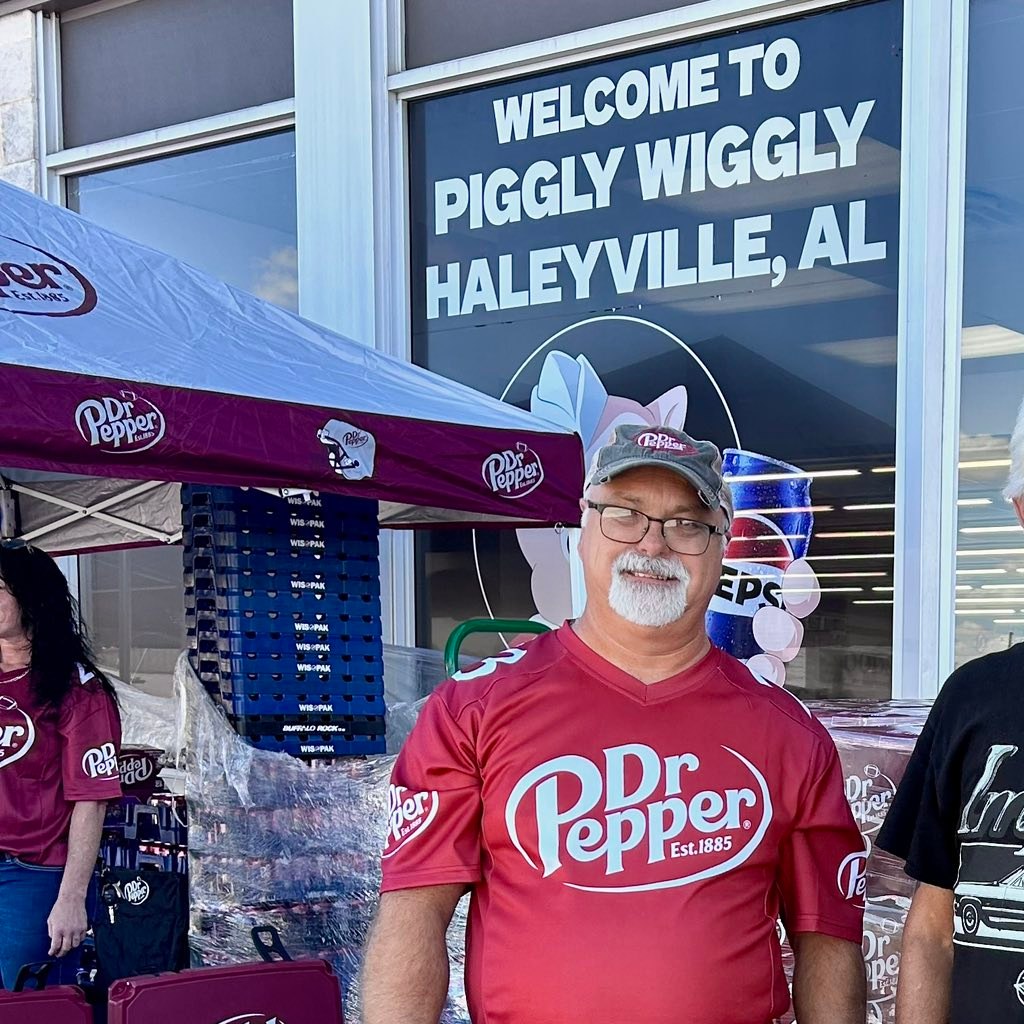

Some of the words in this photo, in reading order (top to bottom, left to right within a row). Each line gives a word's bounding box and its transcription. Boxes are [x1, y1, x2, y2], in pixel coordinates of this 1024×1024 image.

[493, 53, 719, 144] WELCOME
[728, 37, 800, 97] TO
[434, 146, 625, 236] PIGGLY
[635, 100, 876, 200] WIGGLY
[426, 214, 787, 320] HALEYVILLE,
[798, 200, 887, 270] AL
[75, 399, 157, 448] Pepper
[102, 397, 134, 423] Dr
[502, 450, 524, 472] Dr
[638, 432, 686, 451] Pepper
[482, 453, 538, 493] Pepper
[715, 565, 786, 610] EPS
[603, 743, 699, 812] Dr
[845, 775, 872, 802] Dr
[505, 754, 757, 878] Pepper
[851, 790, 892, 825] pper
